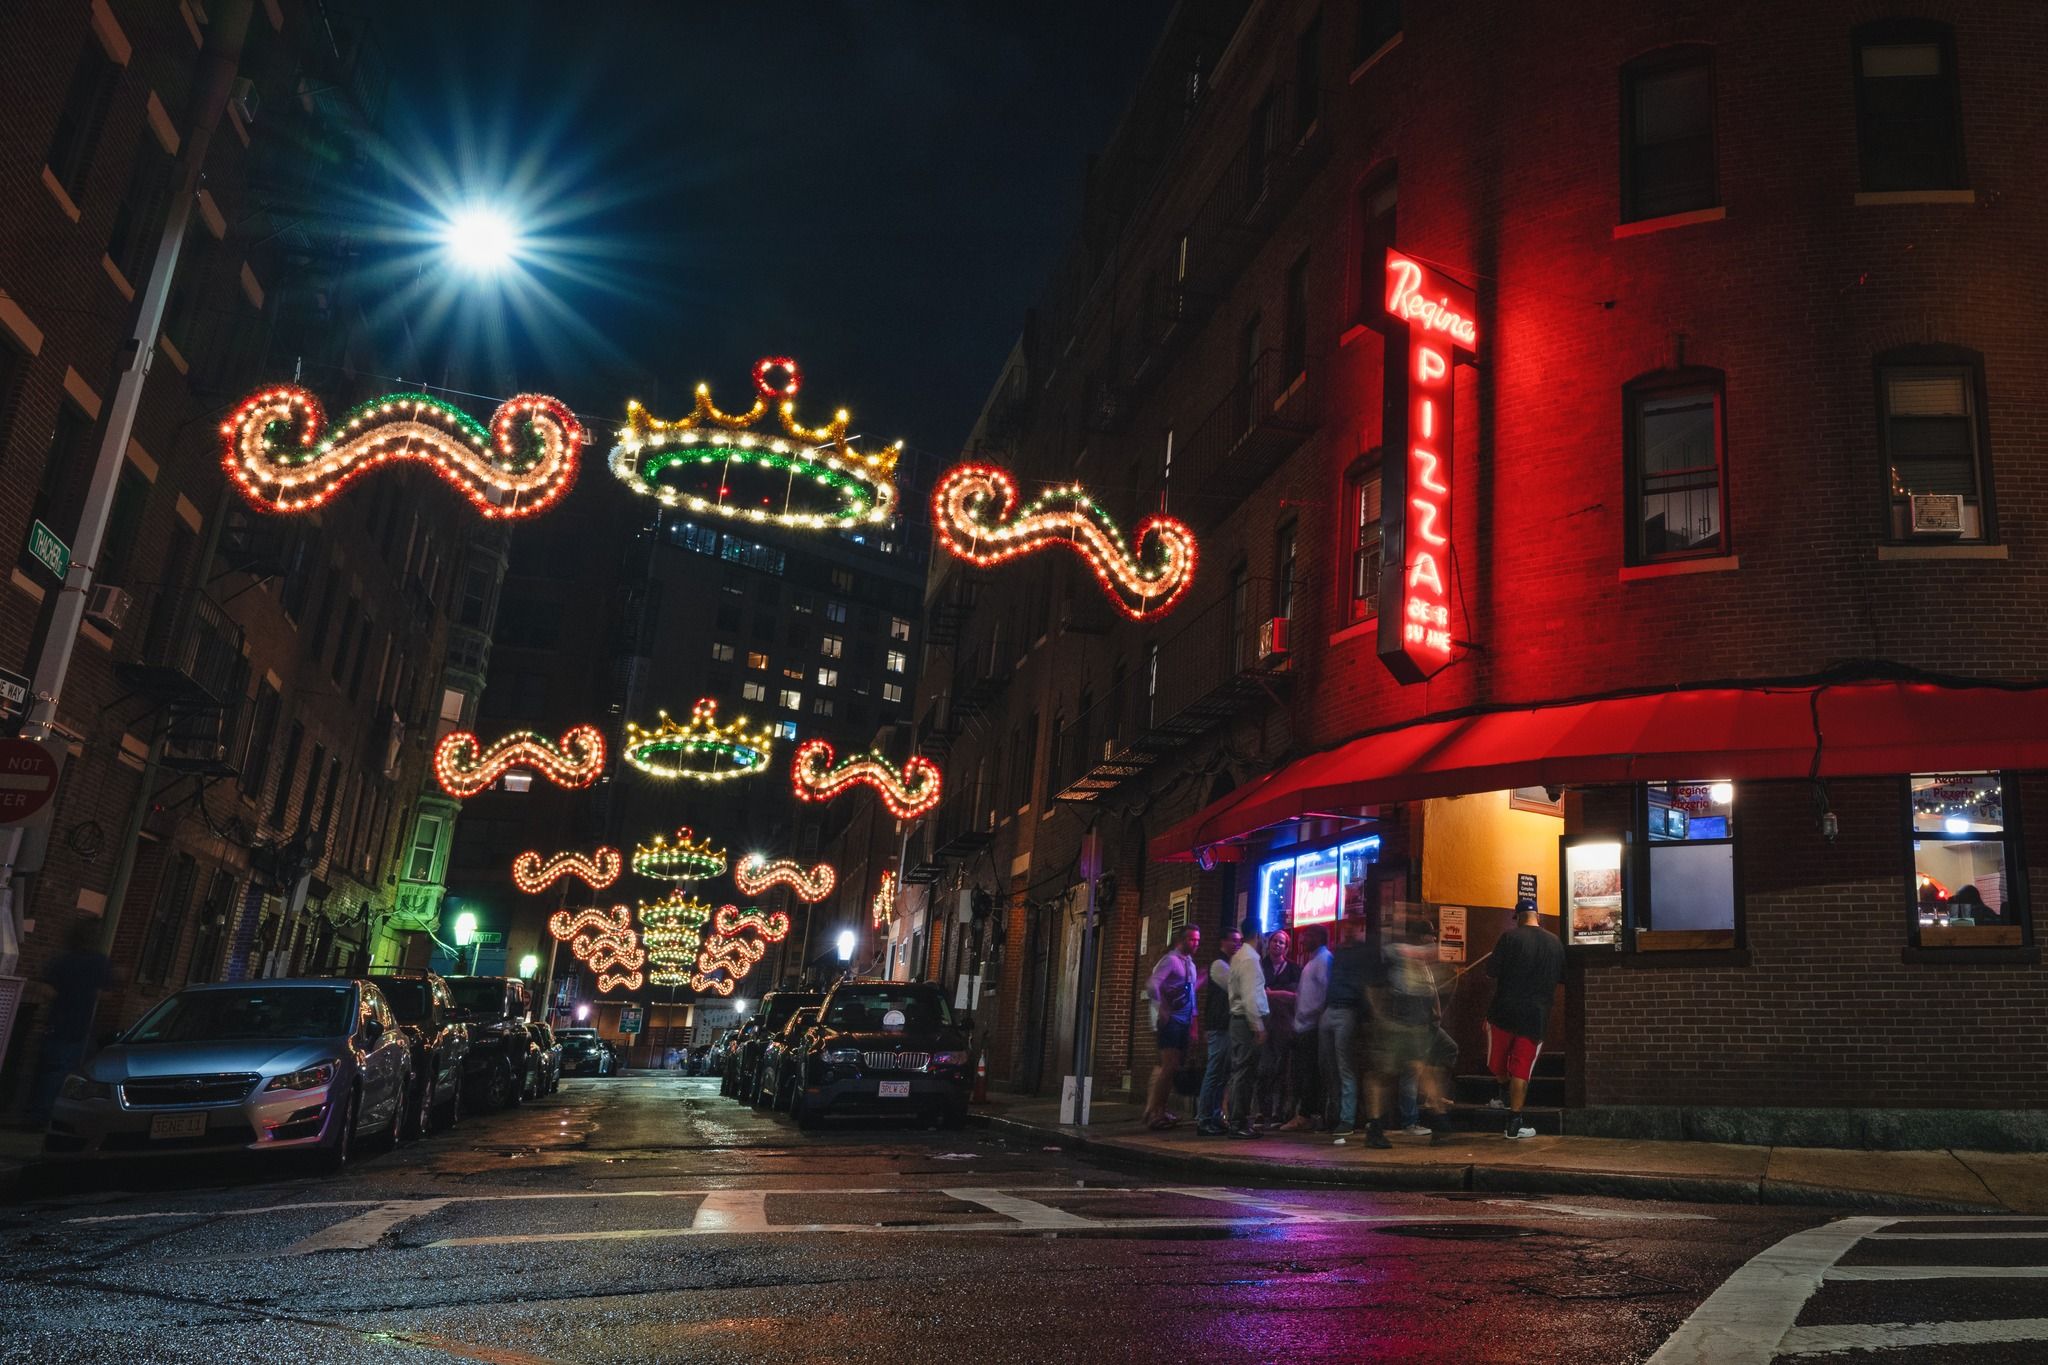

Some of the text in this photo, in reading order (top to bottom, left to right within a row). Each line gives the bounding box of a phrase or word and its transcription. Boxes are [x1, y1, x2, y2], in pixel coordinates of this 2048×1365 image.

[1389, 259, 1476, 345] Regina
[1410, 347, 1446, 596] PIZZA
[34, 528, 61, 570] THACHER
[8, 684, 23, 701] WAY
[8, 756, 42, 771] NOT
[1933, 786, 1976, 801] Pizzeria
